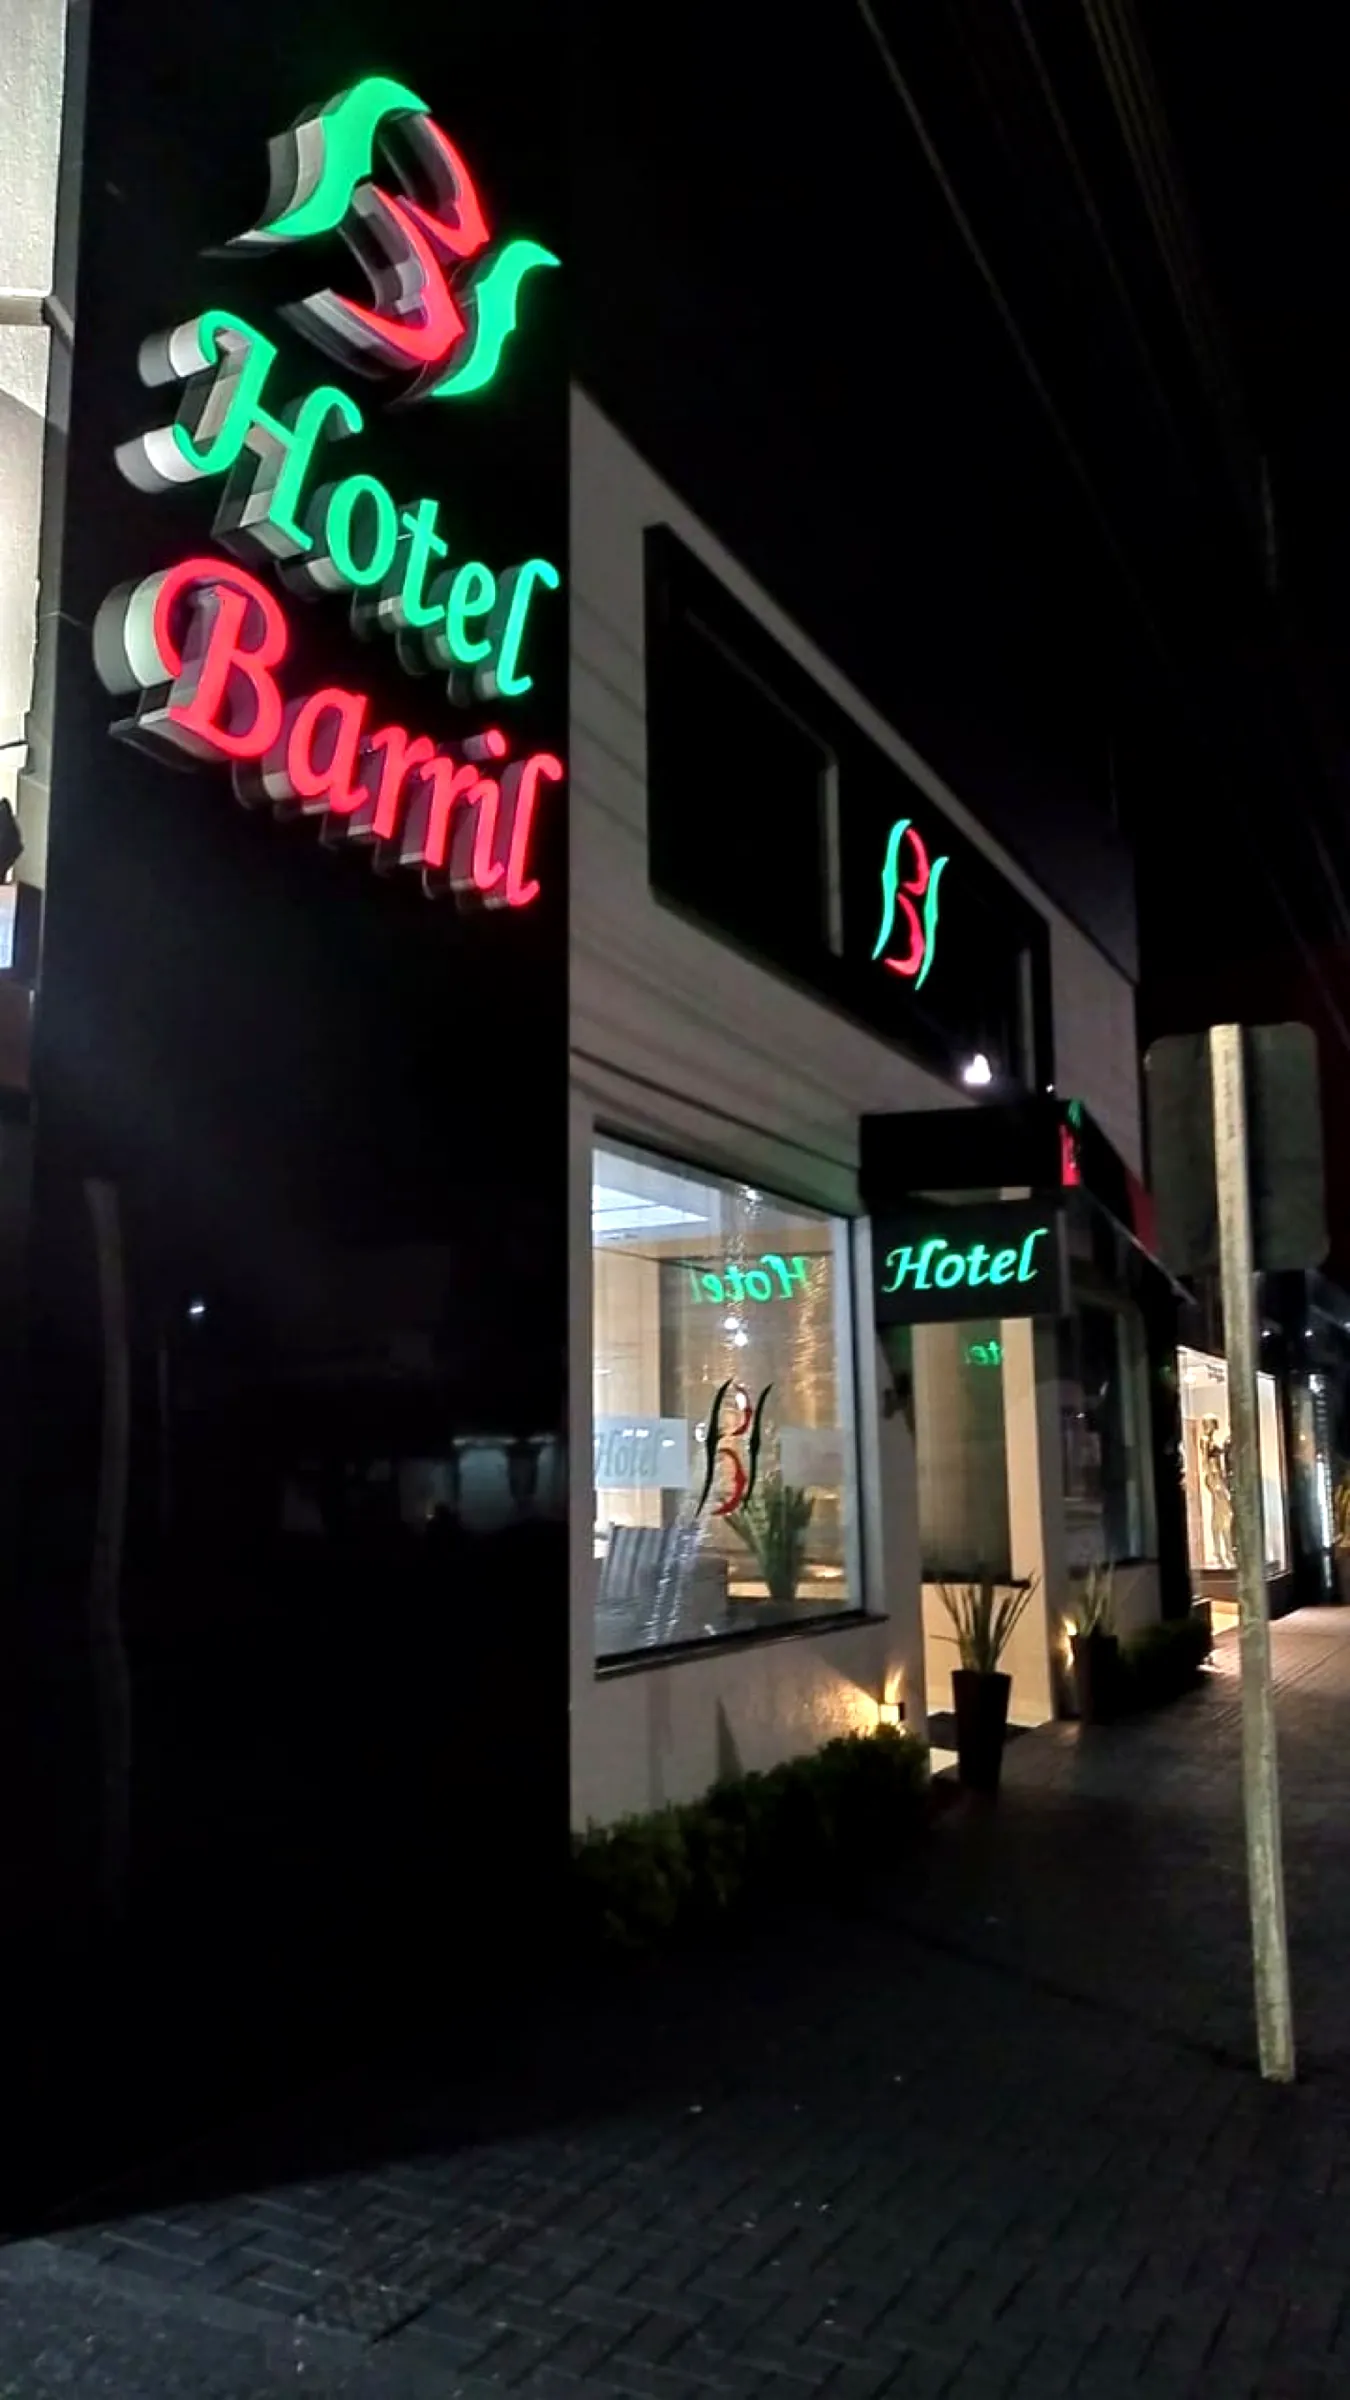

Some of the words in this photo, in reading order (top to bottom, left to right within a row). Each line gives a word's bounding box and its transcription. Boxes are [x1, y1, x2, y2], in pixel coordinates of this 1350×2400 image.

[172, 310, 559, 696] Hotel
[154, 557, 563, 906] Barril
[881, 1226, 1048, 1292] Hotel
